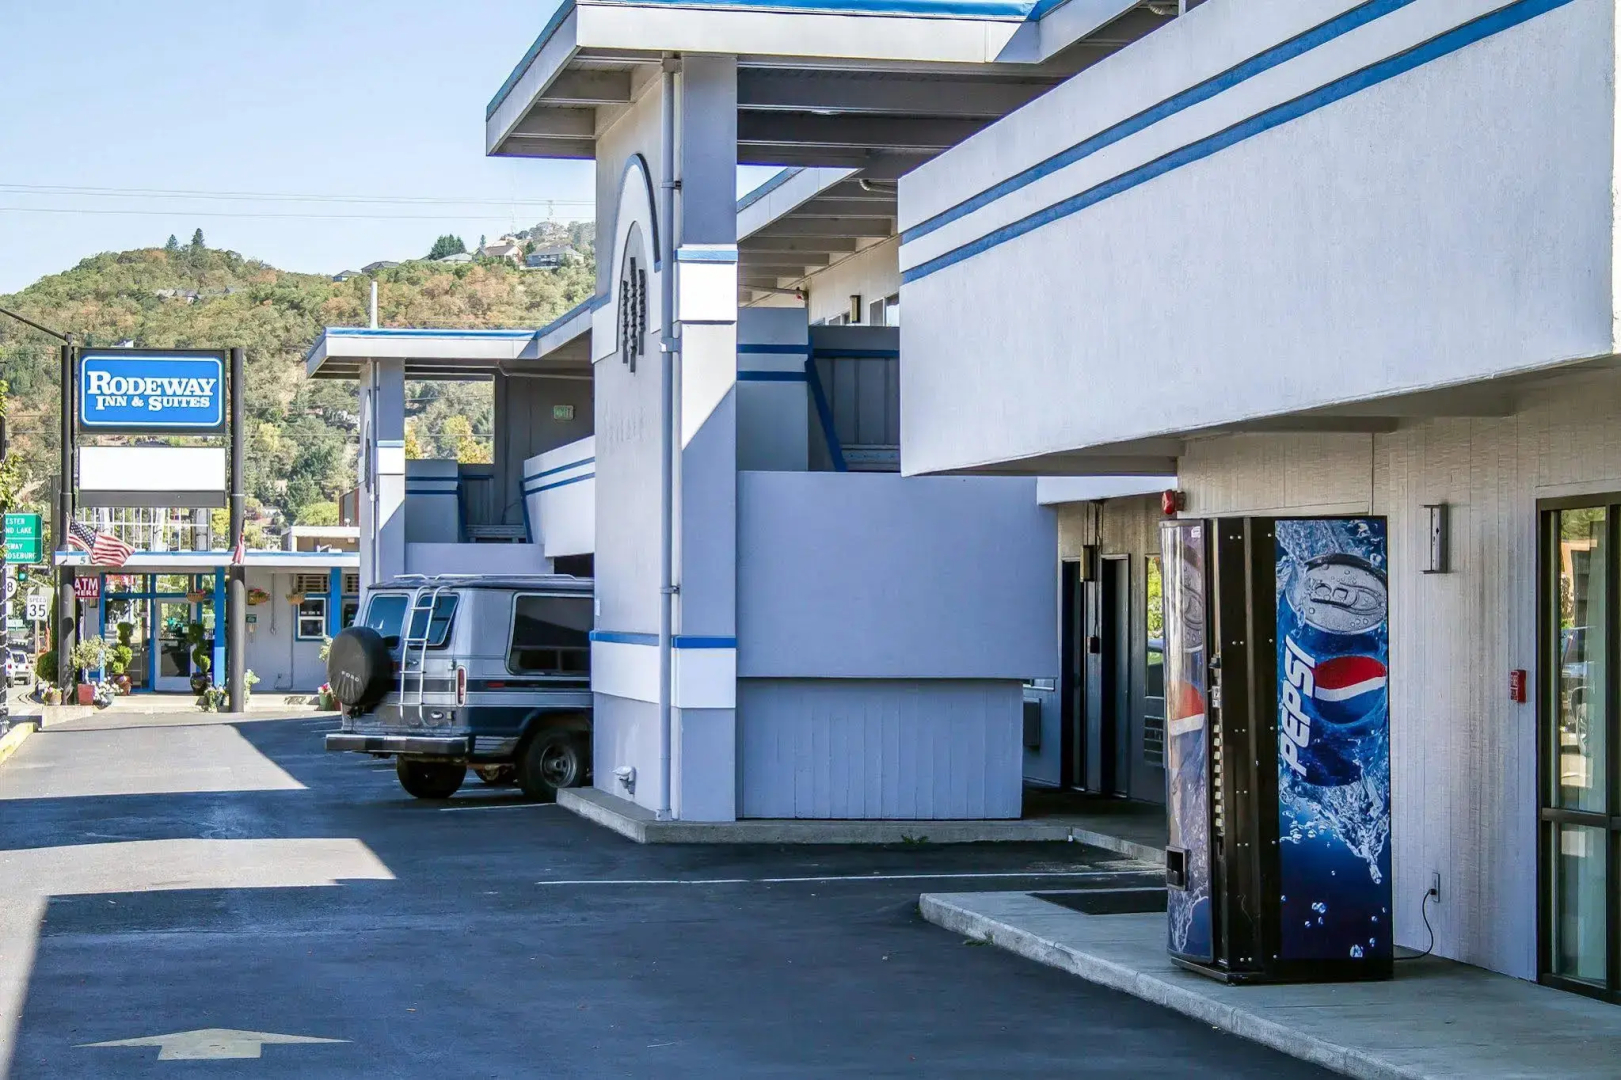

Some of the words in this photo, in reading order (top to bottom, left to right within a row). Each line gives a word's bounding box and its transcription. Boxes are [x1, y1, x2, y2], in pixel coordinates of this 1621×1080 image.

[87, 370, 217, 396] RODEWAY
[95, 395, 127, 410] INN
[131, 396, 145, 408] &
[148, 396, 210, 412] SUITES
[74, 577, 99, 591] ATM
[29, 604, 46, 618] 35
[1280, 634, 1316, 777] PEPSI
